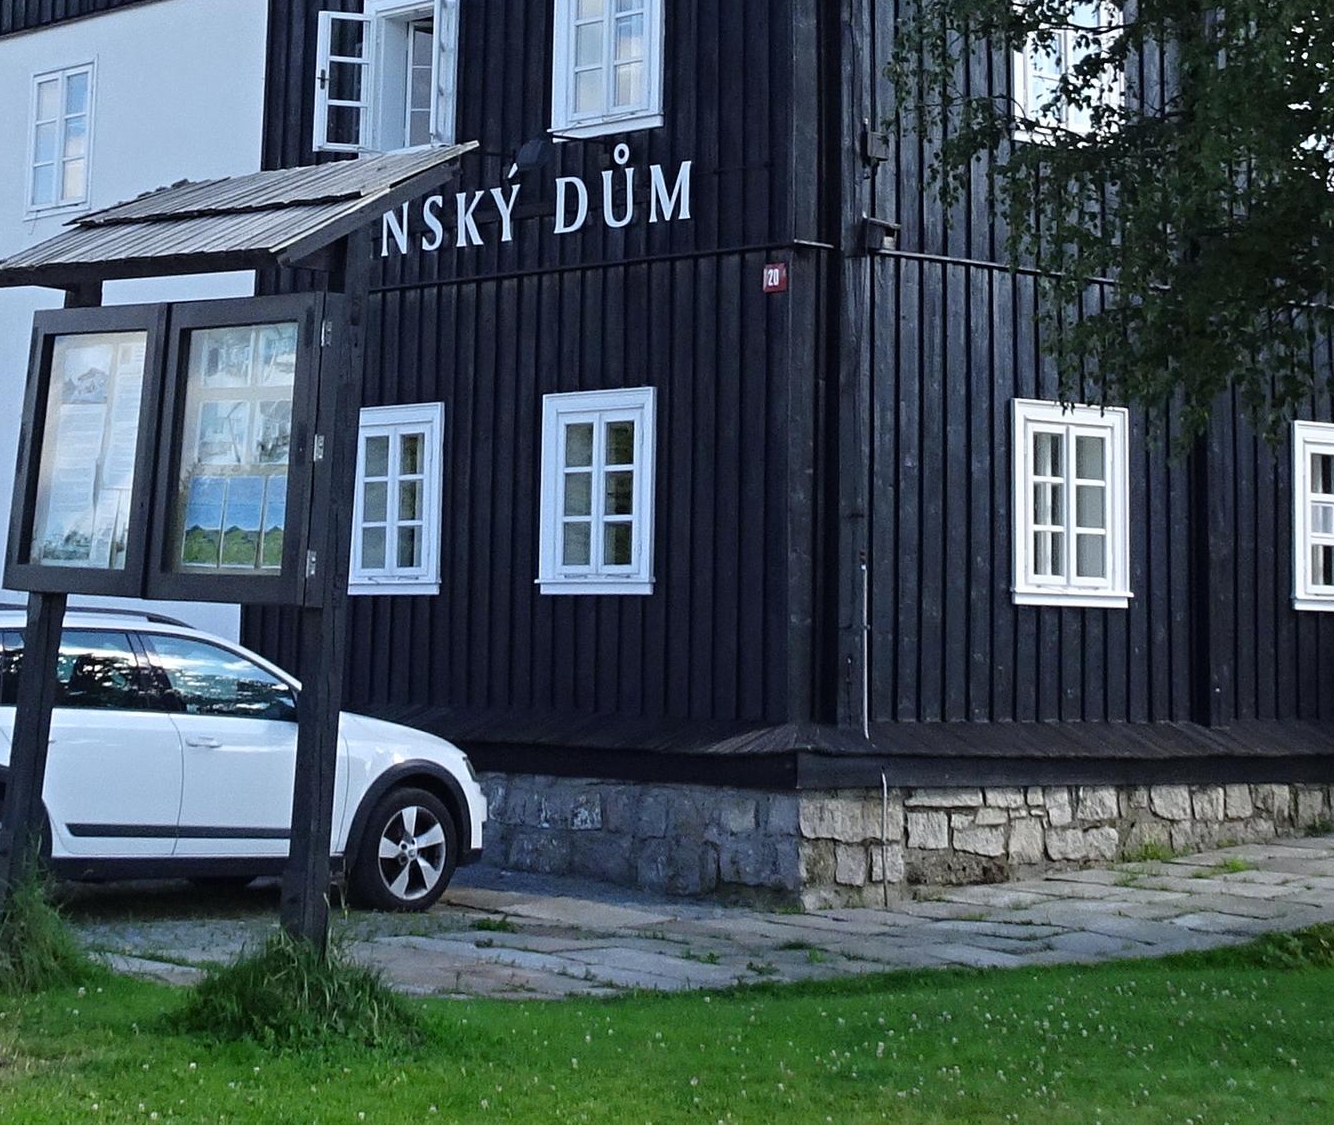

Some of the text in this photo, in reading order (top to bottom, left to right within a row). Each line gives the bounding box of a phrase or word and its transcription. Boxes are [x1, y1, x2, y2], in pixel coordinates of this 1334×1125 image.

[380, 143, 692, 257] NSKÝ DŮM
[767, 268, 779, 286] 20
